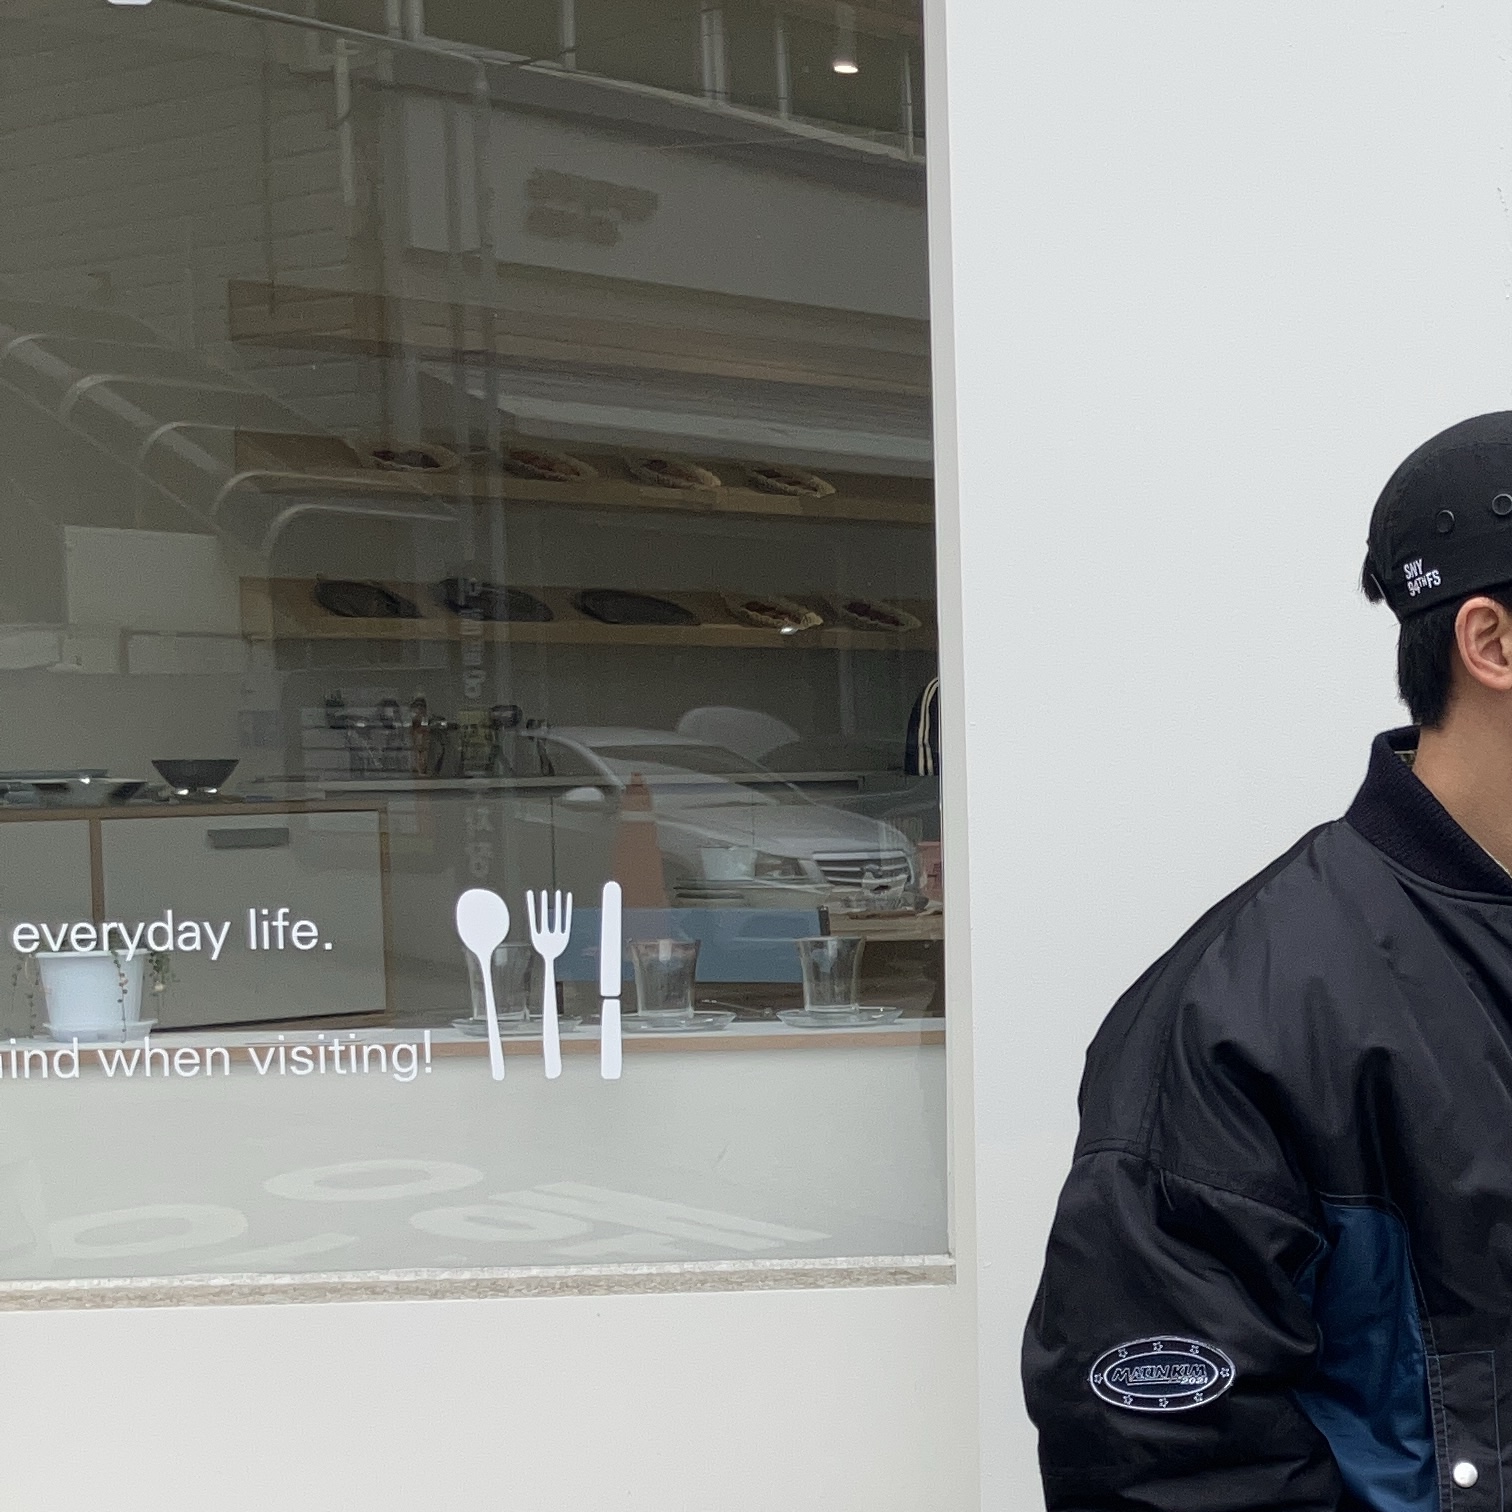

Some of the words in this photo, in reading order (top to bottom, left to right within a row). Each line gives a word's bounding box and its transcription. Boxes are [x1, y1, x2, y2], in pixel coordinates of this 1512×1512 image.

[1403, 558, 1423, 579] SNY
[12, 909, 231, 960] everyday
[248, 907, 334, 951] life.
[0, 1036, 80, 1079] ind
[97, 1036, 231, 1078] when
[248, 1029, 433, 1083] visiting!
[1111, 1365, 1171, 1385] MATIN
[1171, 1363, 1208, 1379] KIM
